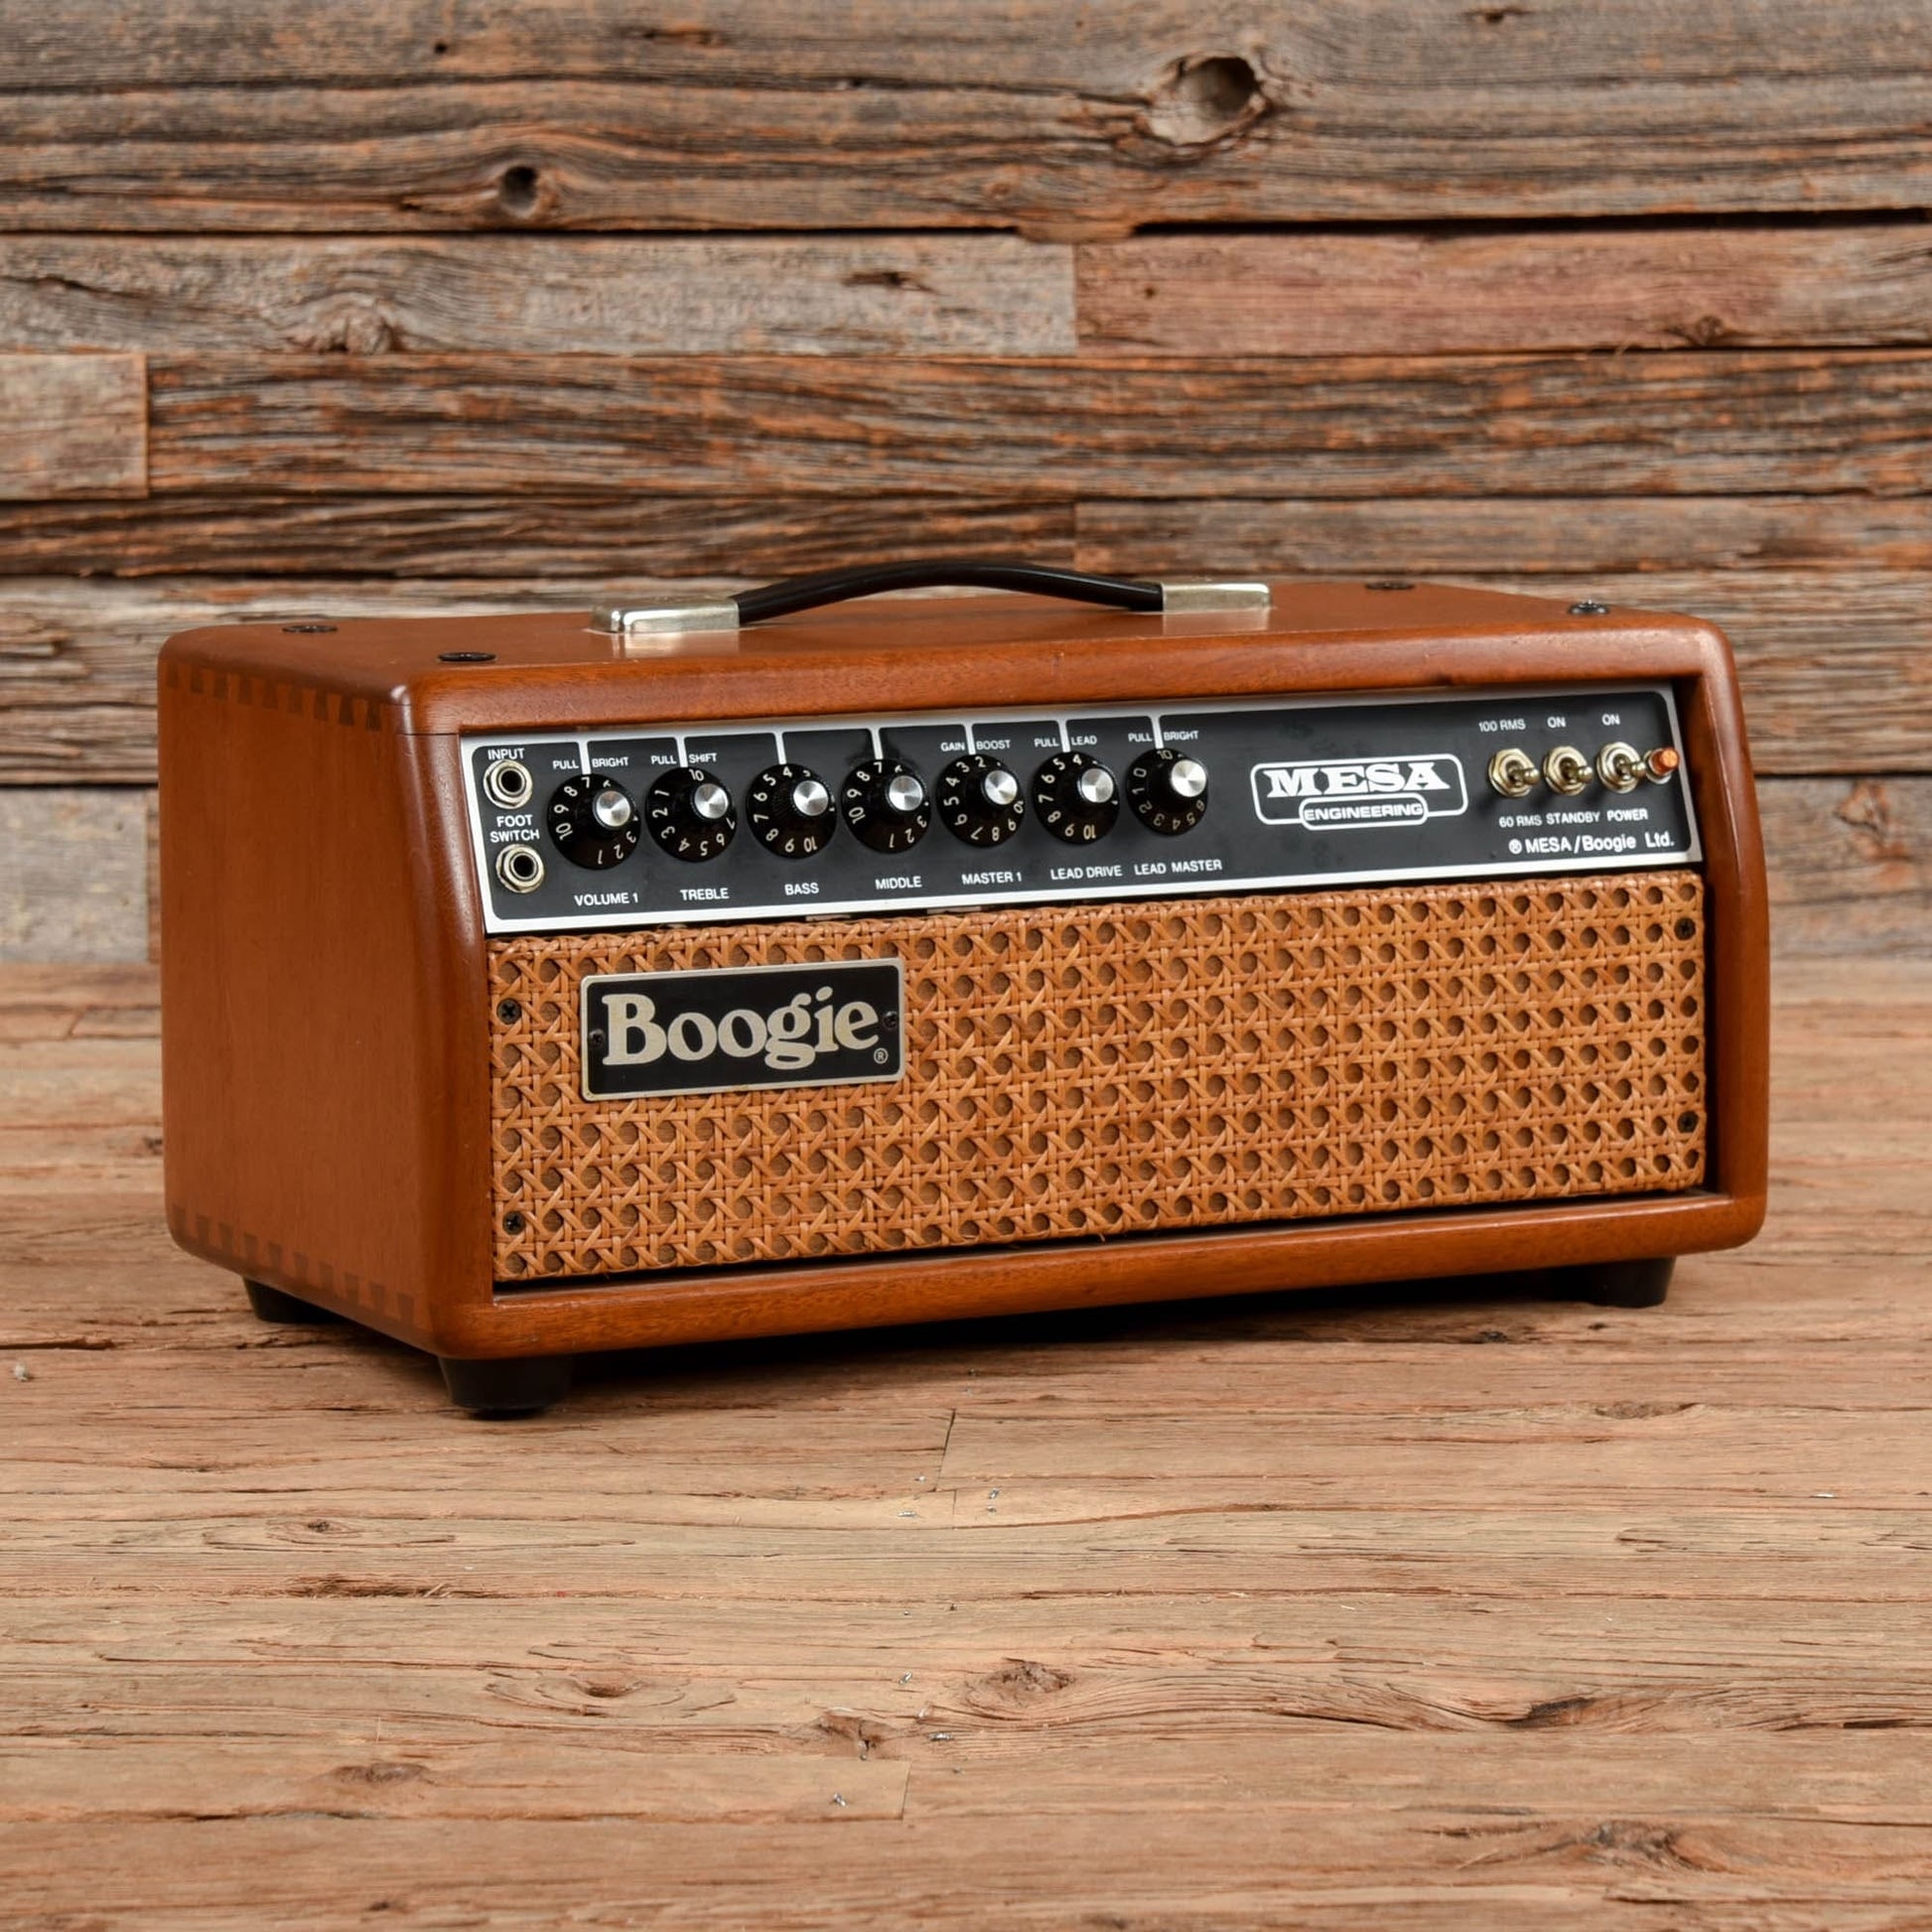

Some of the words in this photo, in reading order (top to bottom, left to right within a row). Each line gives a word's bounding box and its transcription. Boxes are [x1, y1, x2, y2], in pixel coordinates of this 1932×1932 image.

[1478, 720, 1498, 733] 100
[1499, 718, 1527, 731] RMS
[1547, 716, 1567, 729] ON
[1601, 713, 1620, 726] ON
[1035, 738, 1058, 748] PULL
[1071, 736, 1097, 746] LEAD
[1128, 733, 1153, 743] PULL
[1164, 731, 1199, 742] BRIGHT
[940, 742, 965, 753] GAIN
[976, 740, 1011, 751] BOOST
[487, 748, 525, 760] INPUT
[650, 755, 677, 765] PULL
[689, 753, 717, 763] SHIFT
[1072, 754, 1082, 765] 4
[1157, 750, 1173, 759] 10
[552, 759, 579, 770] PULL
[592, 757, 629, 768] BRIGHT
[874, 761, 883, 773] 7
[956, 761, 970, 772] 3
[975, 756, 986, 767] 2
[1052, 758, 1065, 770] 5
[689, 768, 705, 781] 10
[782, 765, 793, 777] 4
[856, 770, 871, 781] 8
[1133, 767, 1147, 777] 0
[581, 776, 590, 788] 7
[762, 774, 776, 786] 5
[945, 776, 960, 787] 4
[1040, 774, 1055, 783] 6
[1262, 761, 1450, 798] MESA
[563, 785, 578, 797] 8
[753, 792, 767, 802] 6
[943, 796, 959, 806] 5
[1037, 794, 1054, 803] 7
[651, 807, 668, 818] 2
[1138, 800, 1153, 813] 2
[1304, 802, 1424, 822] ENGINEERING
[496, 814, 533, 827] FOOT
[754, 814, 769, 823] 7
[848, 806, 866, 824] 10
[916, 815, 927, 828] 3
[1047, 810, 1061, 823] 8
[1153, 813, 1165, 826] 3
[1186, 812, 1195, 825] 5
[1498, 816, 1514, 828] 60
[1516, 814, 1542, 827] RMS
[1546, 811, 1600, 825] STANDBY
[1606, 808, 1648, 822] POWER
[1172, 818, 1180, 830] 4
[489, 829, 540, 843] SWITCH
[556, 822, 574, 841] 10
[625, 831, 636, 843] 3
[660, 826, 675, 840] 3
[765, 828, 778, 841] 8
[904, 828, 914, 844] 2
[970, 826, 984, 840] 7
[992, 826, 1000, 841] 8
[1083, 824, 1096, 840] 10
[678, 838, 691, 852] 4
[803, 836, 818, 853] 10
[889, 833, 895, 848] 1
[1644, 830, 1675, 848] Ltd.
[614, 844, 623, 860] 2
[700, 841, 709, 856] 5
[598, 850, 604, 865] 1
[1050, 868, 1083, 881] LEAD
[1086, 866, 1123, 879] DRIVE
[1134, 863, 1166, 876] LEAD
[1172, 859, 1222, 874] MASTER
[875, 877, 922, 890] MIDDLE
[961, 872, 1015, 886] MASTER
[1017, 872, 1023, 883] 1
[680, 888, 730, 900] TREBLE
[784, 883, 819, 896] BASS
[574, 893, 629, 906] VOLUME
[632, 893, 638, 903] 1
[602, 986, 880, 1069] Boogie
